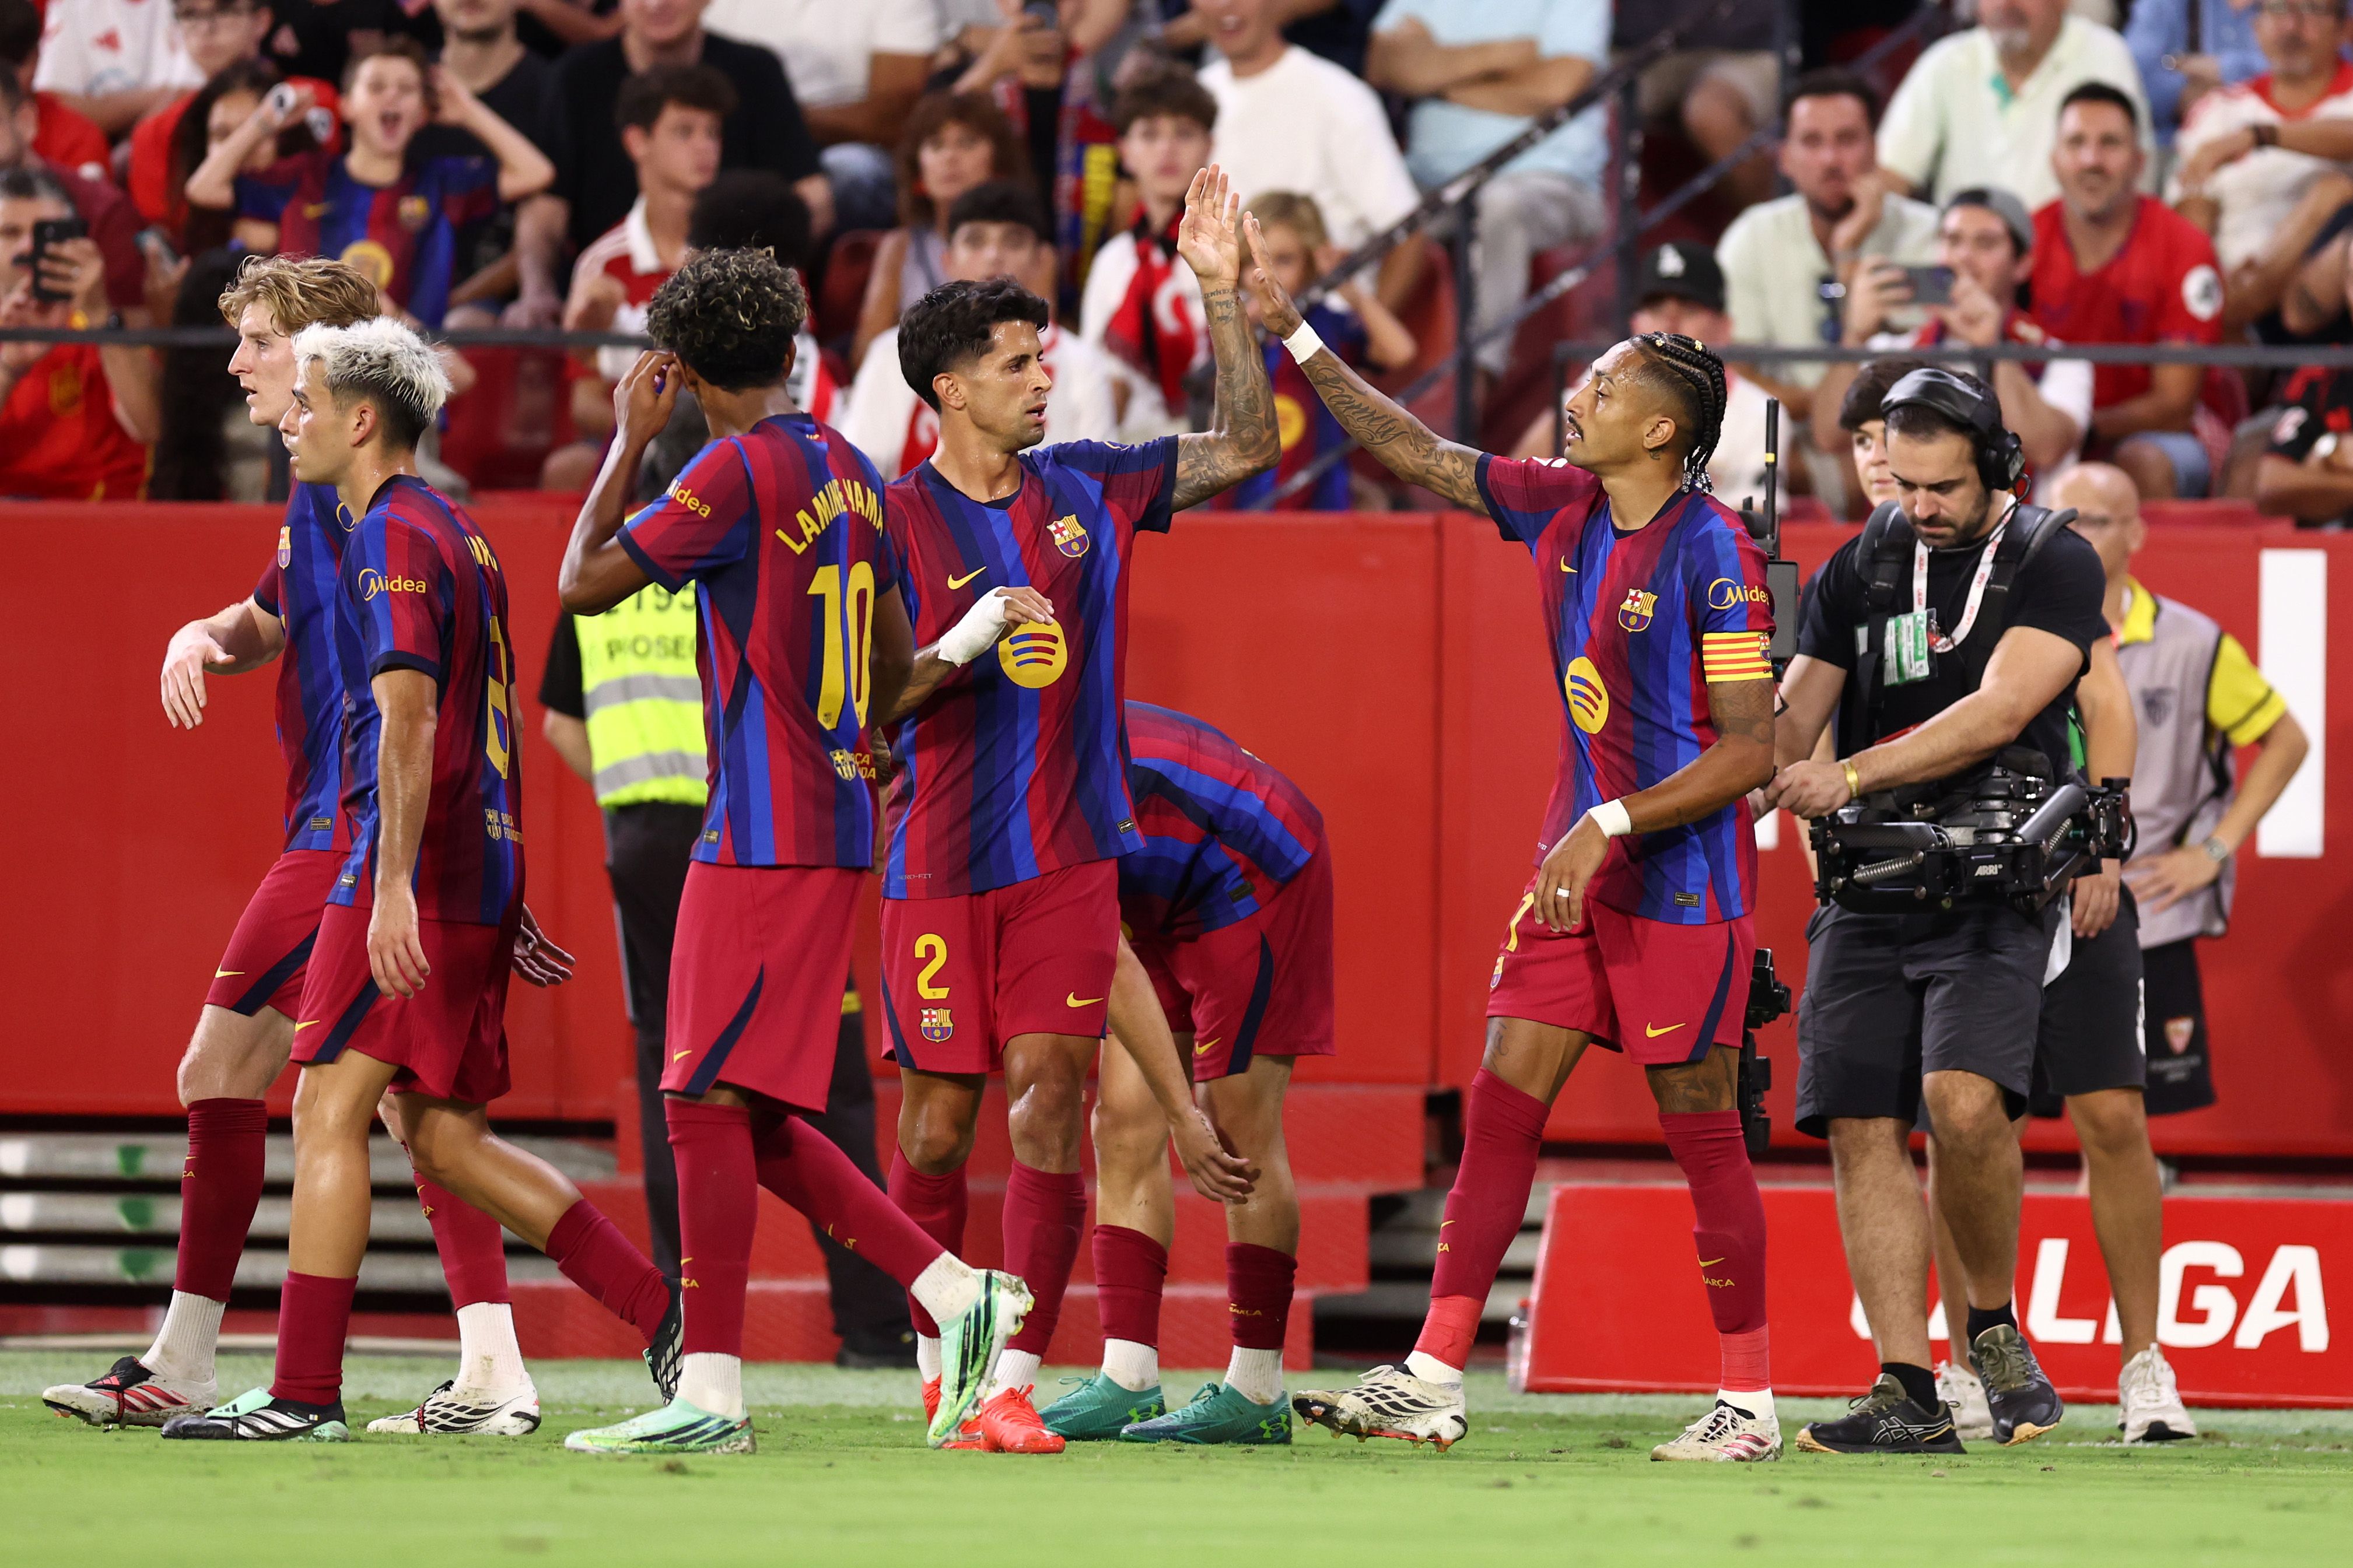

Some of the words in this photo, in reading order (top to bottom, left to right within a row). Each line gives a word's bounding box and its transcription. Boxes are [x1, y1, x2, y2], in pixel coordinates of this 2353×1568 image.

[775, 479, 848, 555] LAMINE
[842, 478, 883, 538] YAMA
[359, 569, 426, 601] Midea
[807, 560, 875, 730] 10
[915, 933, 950, 999] 2
[1850, 1237, 2330, 1353] LGA
